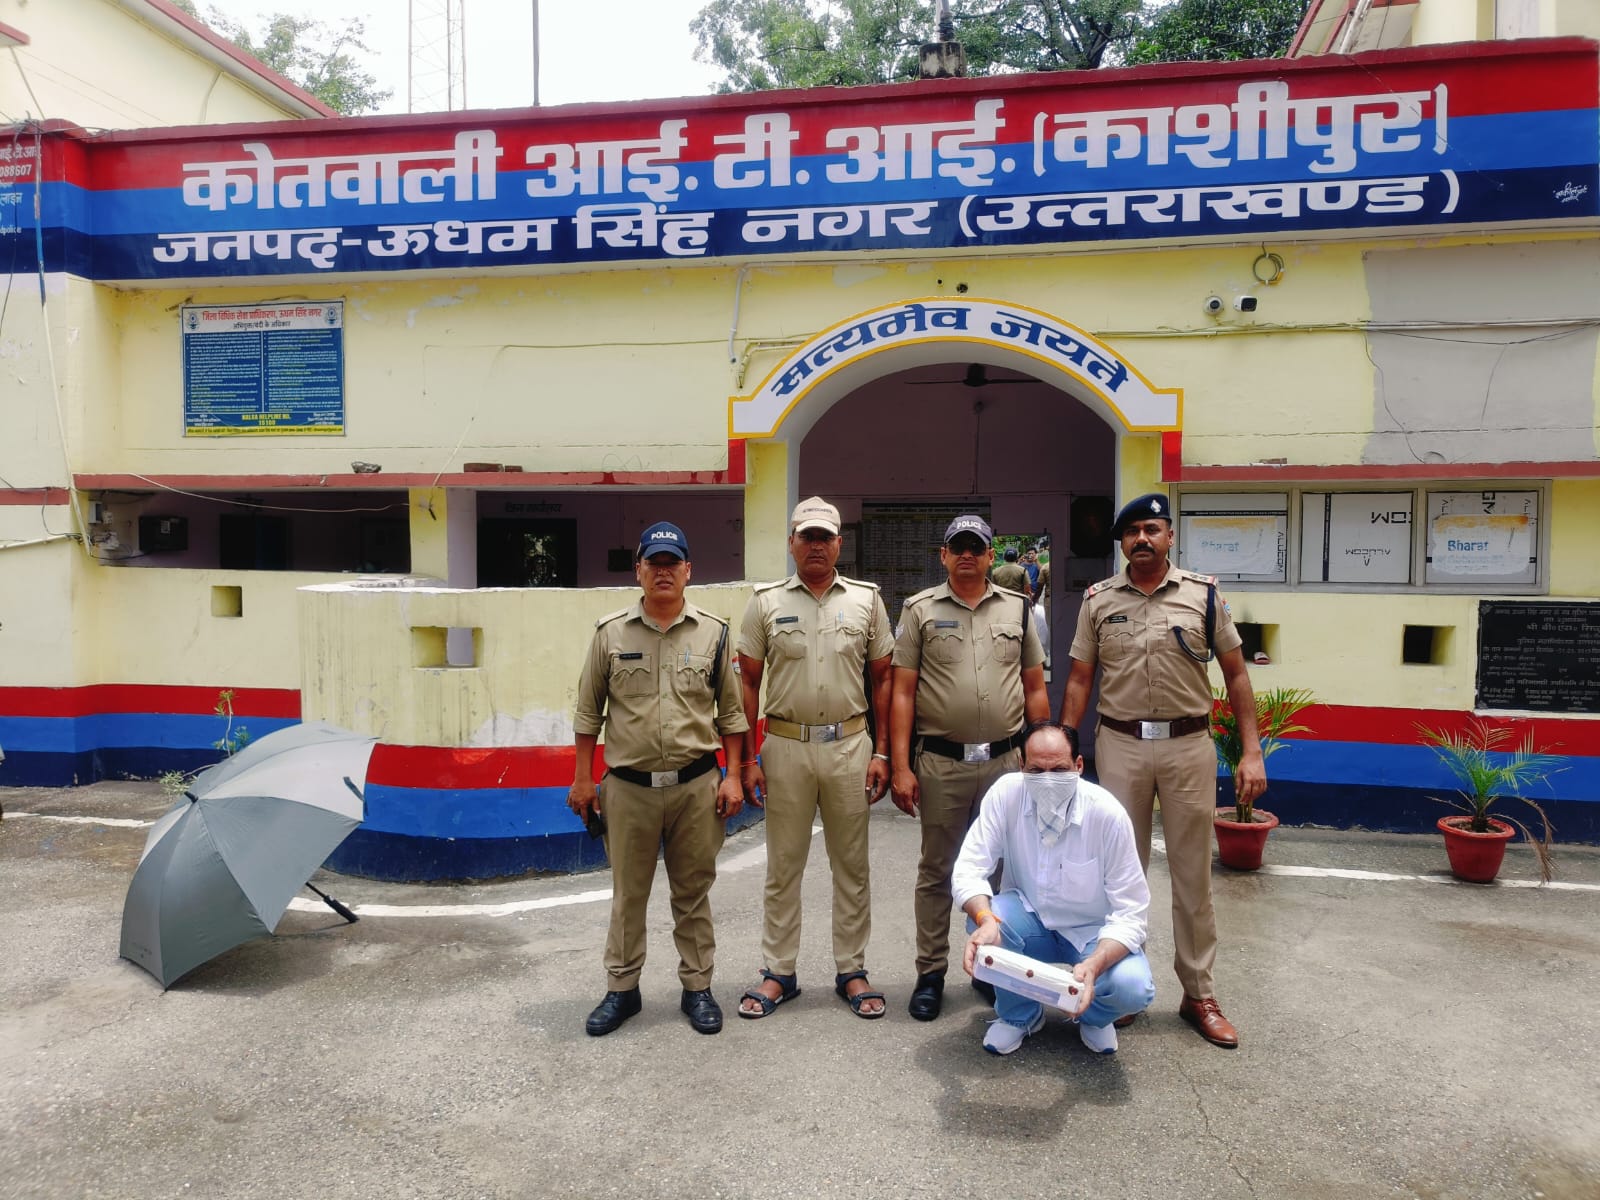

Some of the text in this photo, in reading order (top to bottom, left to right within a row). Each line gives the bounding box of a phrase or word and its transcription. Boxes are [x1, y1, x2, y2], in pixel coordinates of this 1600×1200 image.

[182, 81, 1448, 212] कोतवाली आई. टी. आई. (काशीपुर)
[573, 202, 714, 256] सिंह
[741, 202, 939, 242] नगर
[771, 304, 1130, 397] सत्यमेव जयते
[651, 531, 678, 541] POLICE
